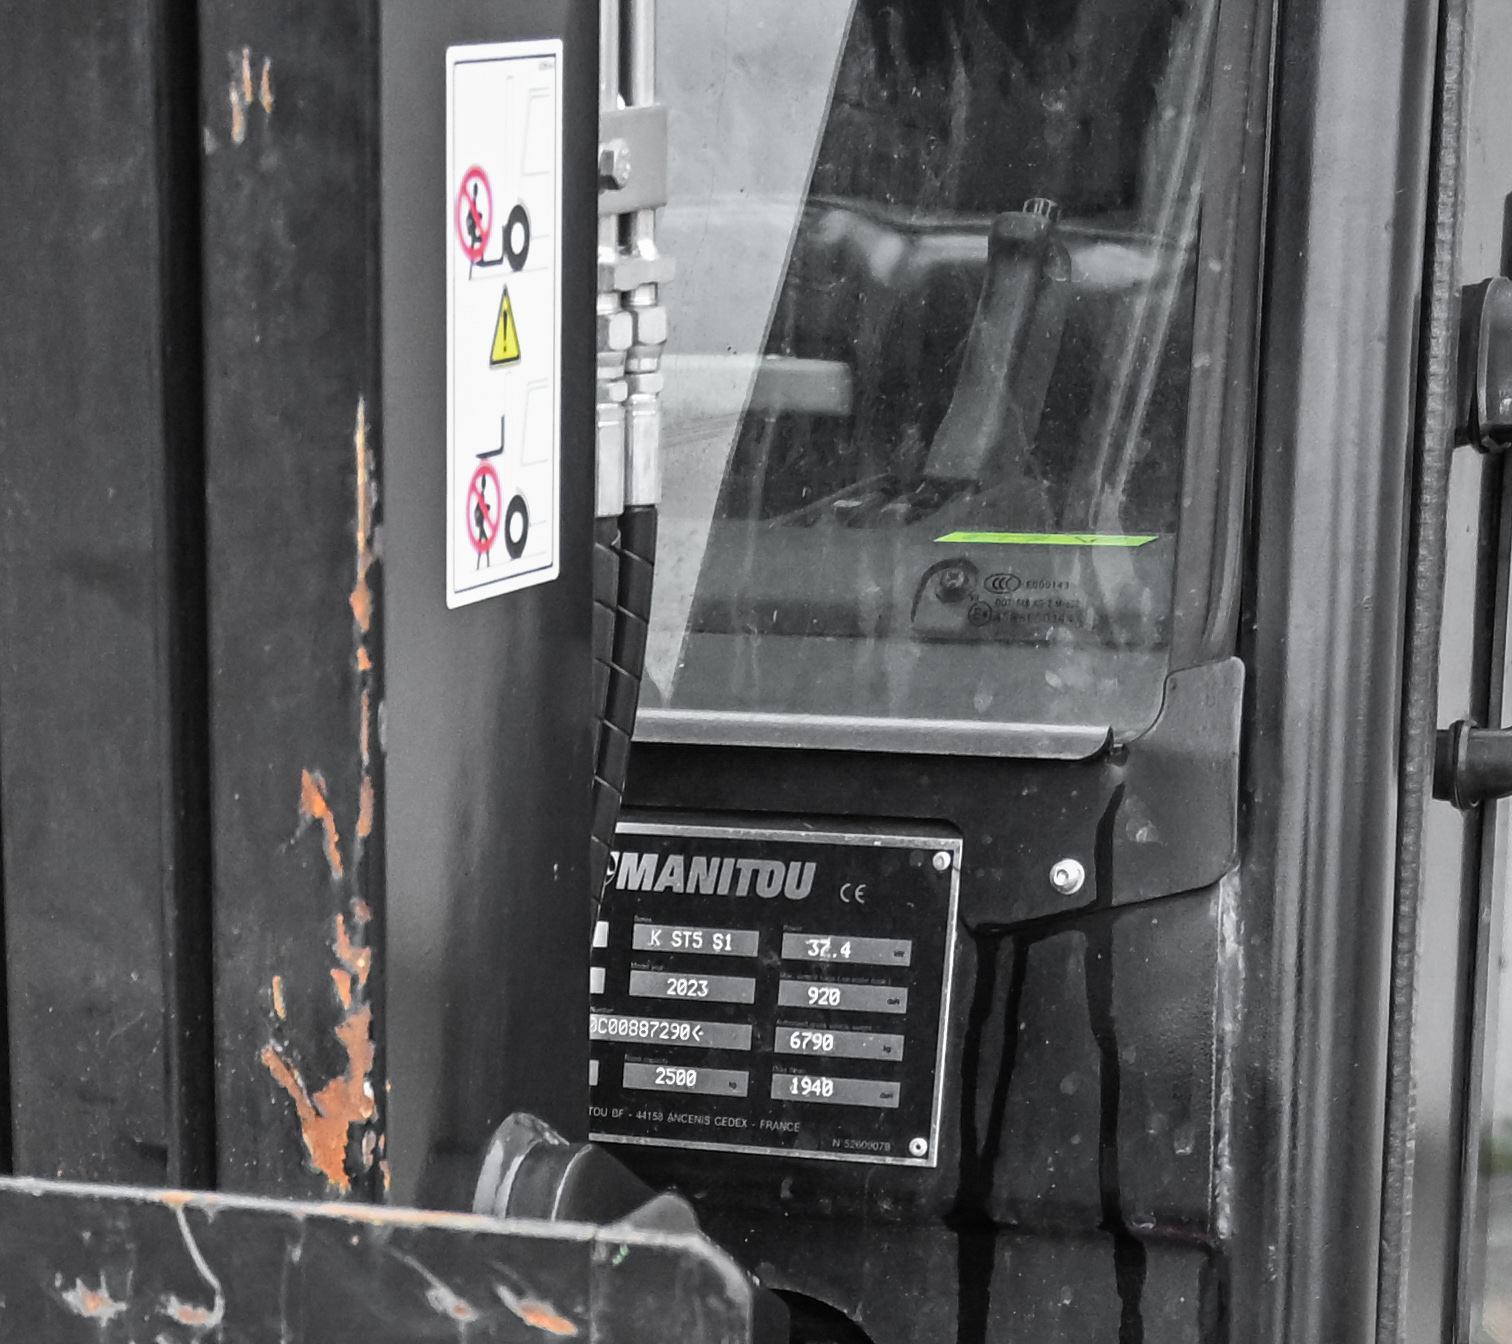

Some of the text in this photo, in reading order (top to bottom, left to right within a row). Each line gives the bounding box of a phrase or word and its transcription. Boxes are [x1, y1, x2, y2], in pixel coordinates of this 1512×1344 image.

[615, 852, 817, 900] MANITOU
[670, 929, 704, 949] ST5
[711, 931, 733, 952] S1
[666, 977, 710, 998] 2023
[807, 985, 842, 1007] 920
[789, 1030, 835, 1052] 6790
[654, 1065, 698, 1088] 2500
[788, 1075, 835, 1098] 1940
[666, 1111, 711, 1126] ANCENIS
[759, 1119, 801, 1133] FRANCE
